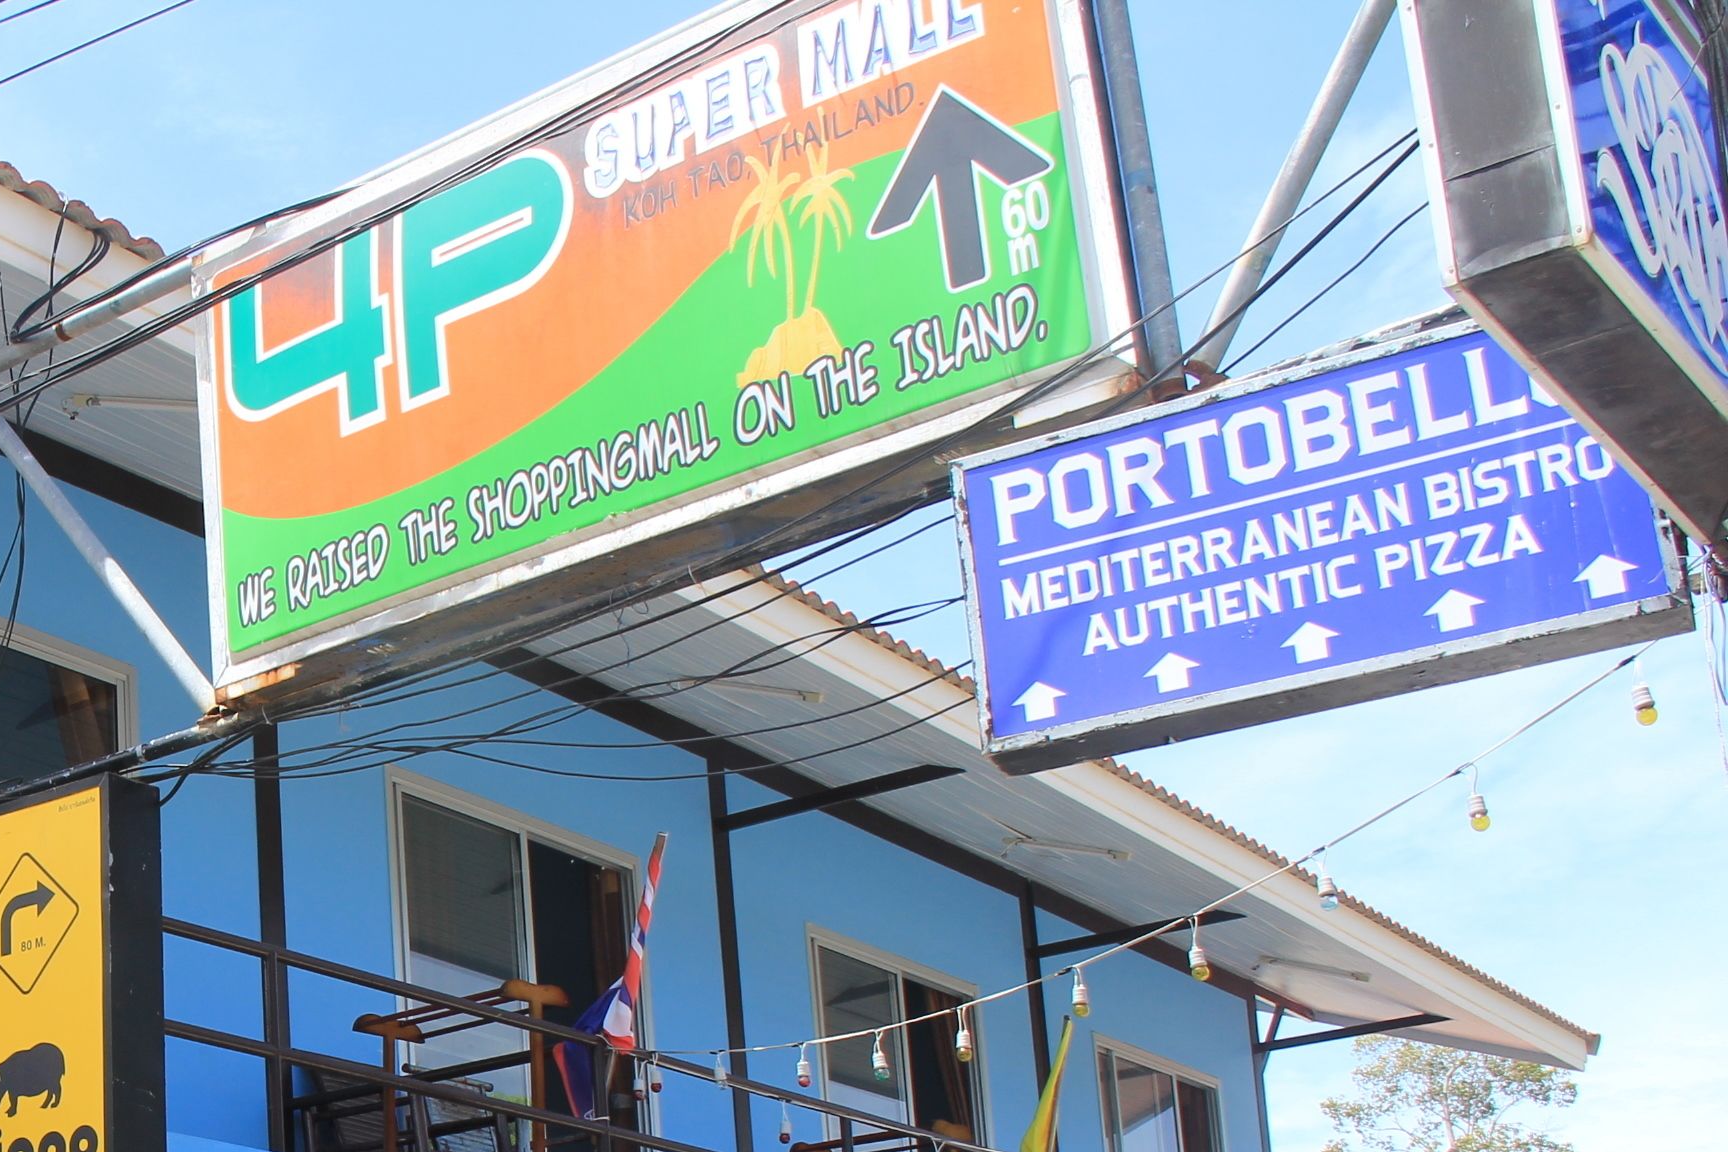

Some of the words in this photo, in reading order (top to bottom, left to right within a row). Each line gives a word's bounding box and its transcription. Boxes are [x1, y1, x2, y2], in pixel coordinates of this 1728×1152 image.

[584, 42, 785, 199] SUPER
[796, 0, 985, 108] MALL
[622, 178, 678, 230] KOH
[687, 150, 754, 200] TAO,
[759, 80, 925, 168] THAILAND.
[1000, 179, 1050, 236] 60
[1006, 232, 1041, 277] m
[223, 147, 575, 438] 4P
[236, 569, 276, 630] WE
[285, 521, 391, 613] RAISED
[404, 501, 458, 566] THE
[470, 420, 719, 549] SHOPPINGMALL
[733, 377, 796, 446] ON
[803, 343, 880, 413] THE
[894, 283, 1049, 396] ISLAND.
[988, 344, 1571, 548] PORTOBELL
[998, 483, 1412, 619] MEDITERRANEAN
[1427, 433, 1620, 521] BISTRO
[1082, 554, 1363, 658] AUTHENTIC
[1373, 513, 1543, 590] PIZZA
[21, 940, 32, 952] 80
[35, 936, 47, 949] M.
